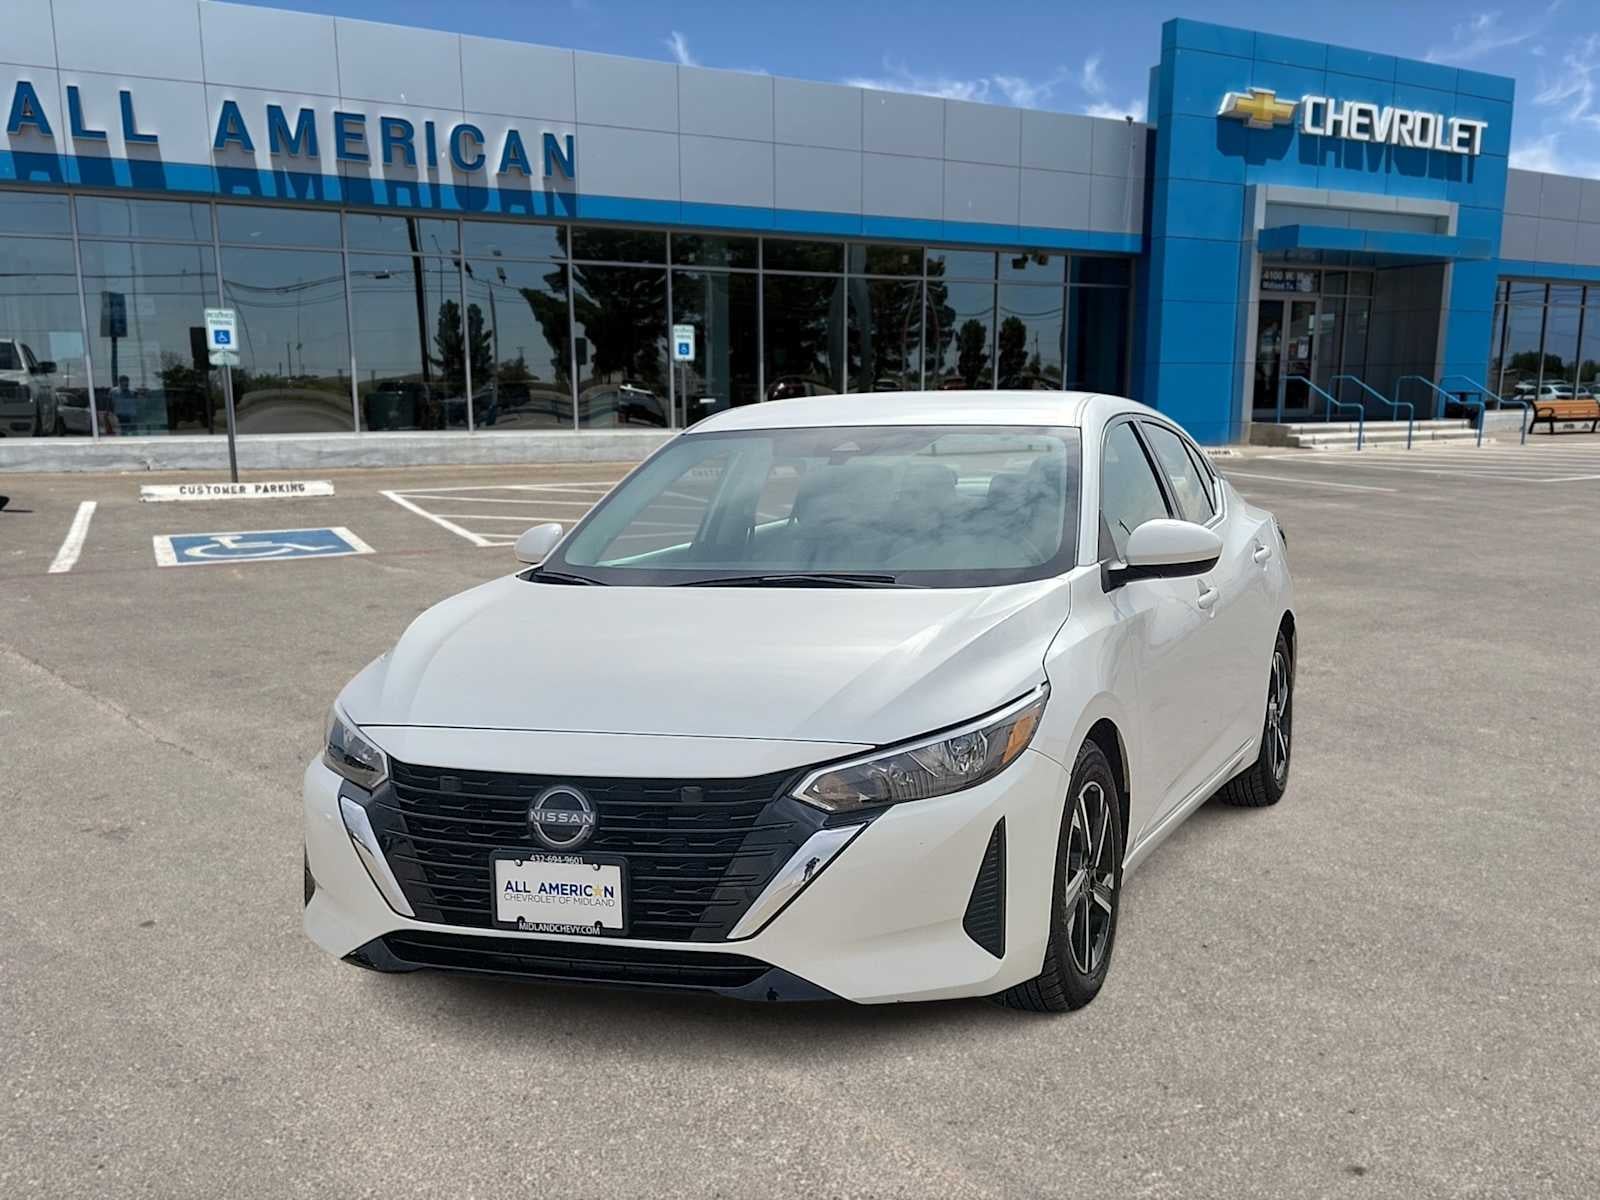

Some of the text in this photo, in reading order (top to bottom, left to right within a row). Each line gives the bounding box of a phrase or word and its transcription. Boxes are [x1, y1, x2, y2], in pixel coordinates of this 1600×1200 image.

[6, 80, 576, 179] ALL AMERICAN
[1300, 94, 1488, 155] CHEVROLET
[179, 483, 305, 495] CUSTOMER PARKING
[530, 811, 594, 823] NISSAN
[530, 854, 583, 865] 432-694-9601
[504, 880, 531, 893] ALL
[503, 892, 615, 907] CHEVROLET OF MIDLAND
[518, 921, 601, 935] MIDLANDCHEVY.COM
